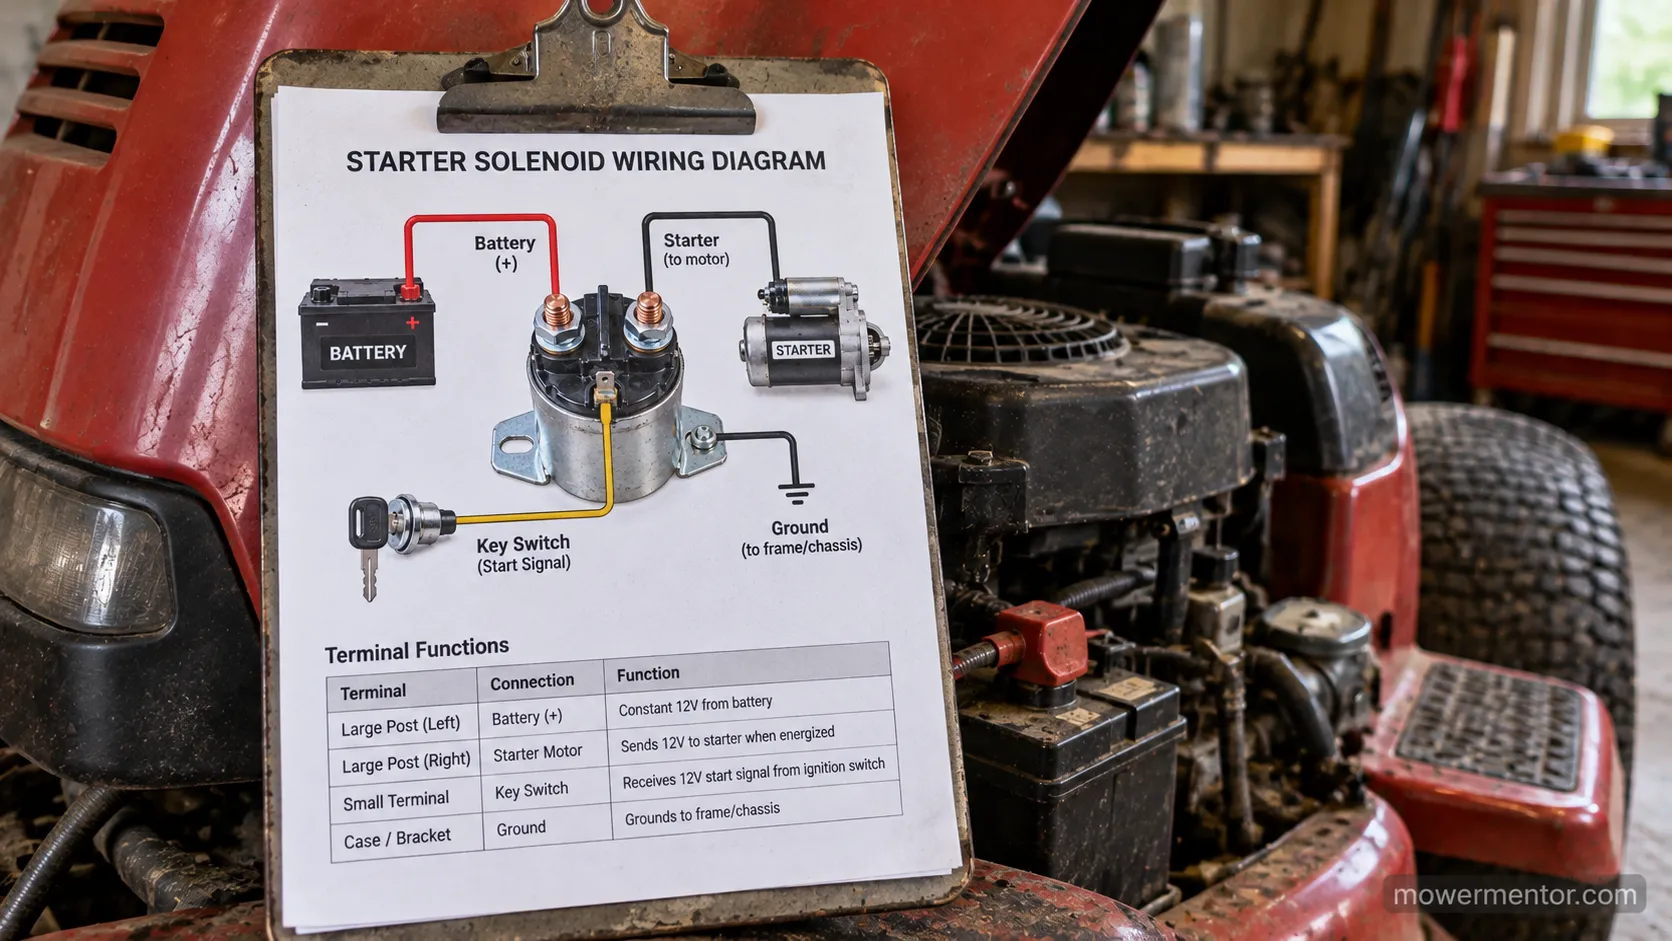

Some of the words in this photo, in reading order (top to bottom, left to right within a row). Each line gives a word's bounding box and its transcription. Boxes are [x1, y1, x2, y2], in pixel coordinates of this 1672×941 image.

[347, 151, 466, 172] STARTER
[475, 151, 604, 171] SOLENOID
[612, 151, 704, 171] WIRING
[712, 151, 825, 170] DIAGRAM
[475, 236, 536, 253] Battery
[664, 233, 719, 247] Starter
[496, 255, 517, 273] (+)
[664, 253, 680, 268] (to
[686, 252, 729, 267] motor)
[331, 345, 406, 360] BATTERY
[777, 344, 831, 356] STARTER
[772, 519, 828, 535] Ground
[478, 539, 508, 556] Key
[514, 534, 570, 551] Switch
[742, 543, 760, 559] (to
[764, 537, 862, 555] frame/chassis)
[478, 559, 518, 576] (Start
[522, 555, 570, 573] Signal)
[325, 642, 408, 663] Terminal
[416, 638, 509, 658] Functions
[491, 673, 574, 690] Connection
[618, 667, 679, 682] Function
[341, 683, 406, 700] Terminal
[619, 702, 672, 716] Constant
[677, 700, 698, 712] 12V
[702, 698, 729, 710] from
[732, 697, 772, 709] battery
[342, 723, 382, 738] Large
[387, 719, 418, 733] Post
[423, 715, 460, 733] (Left)
[493, 712, 540, 726] Battery
[545, 708, 562, 724] (+)
[622, 738, 658, 752] Sends
[663, 736, 684, 749] 12V
[688, 737, 700, 747] to
[704, 734, 742, 746] starter
[745, 731, 776, 743] when
[780, 725, 834, 742] energized
[343, 761, 383, 775] Large
[388, 756, 419, 770] Post
[424, 751, 470, 770] (Right)
[494, 748, 538, 762] Starter
[544, 745, 582, 758] Motor
[623, 776, 676, 789] Receives
[680, 771, 702, 784] 12V
[706, 770, 732, 782] start
[736, 766, 770, 782] signal
[773, 764, 800, 777] from
[804, 761, 845, 777] ignition
[849, 757, 885, 771] switch
[344, 795, 383, 811] Small
[388, 790, 448, 807] Terminal
[496, 786, 520, 801] Key
[524, 781, 568, 797] Switch
[626, 810, 677, 825] Grounds
[680, 810, 692, 821] to
[696, 804, 780, 819] frame/chassis
[497, 820, 545, 836] Ground
[345, 835, 380, 849] Case
[386, 832, 391, 847] /
[397, 829, 451, 845] Bracket
